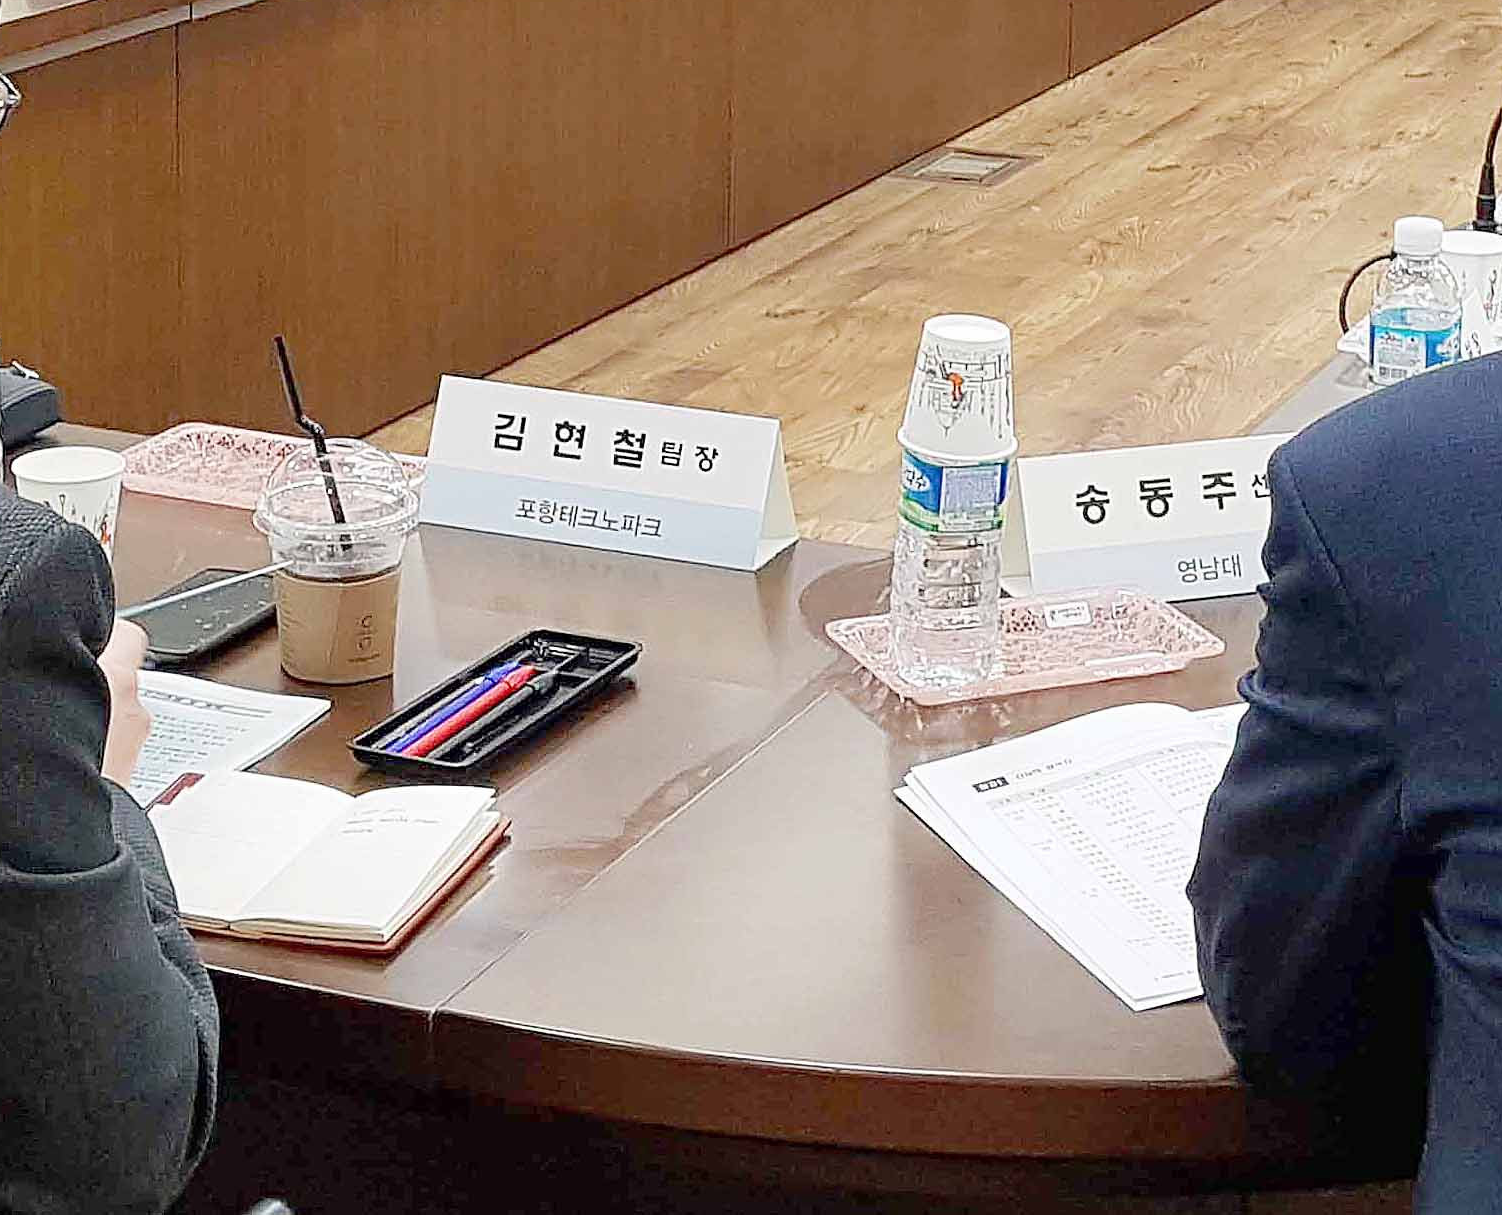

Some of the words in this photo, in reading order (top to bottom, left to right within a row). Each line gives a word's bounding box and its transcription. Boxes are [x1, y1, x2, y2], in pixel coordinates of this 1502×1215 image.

[493, 412, 647, 470] 김현철
[660, 441, 720, 473] 팀장
[514, 497, 663, 538] 포항테크노파크
[1075, 471, 1238, 526] 송동주
[1177, 553, 1242, 584] 영남대
